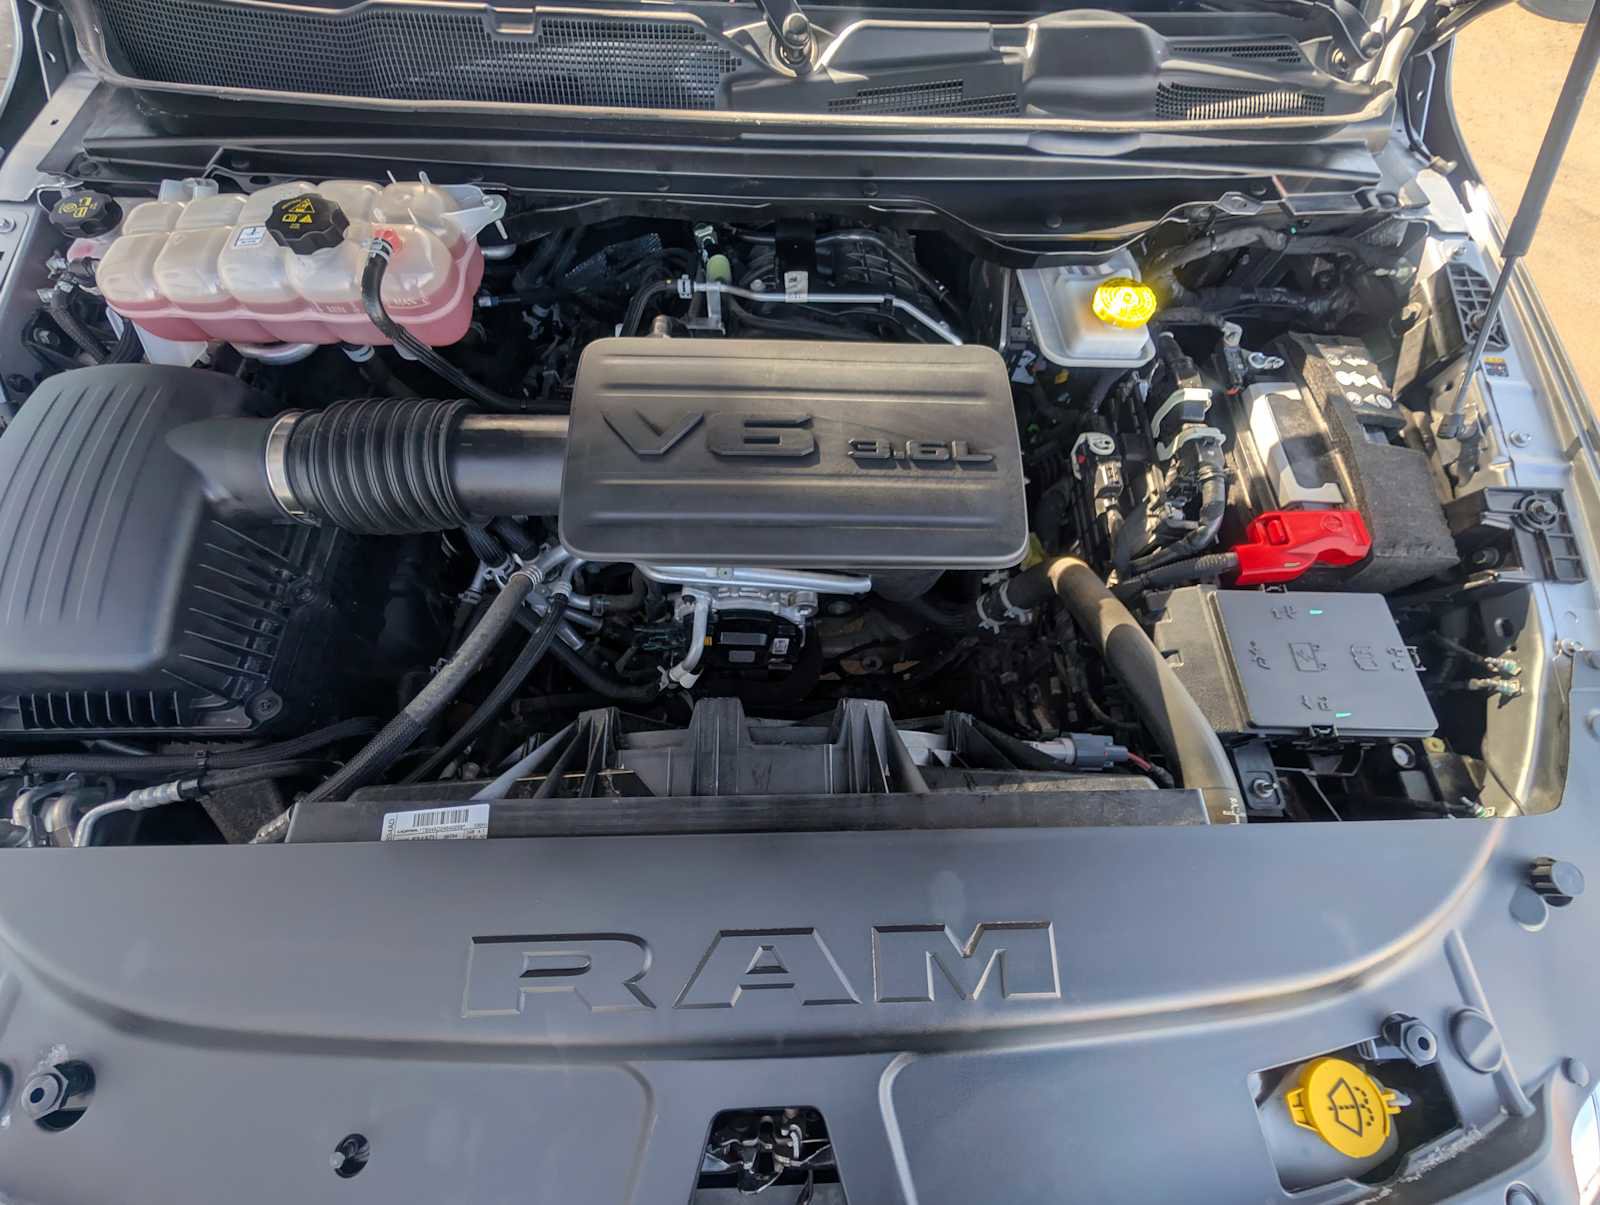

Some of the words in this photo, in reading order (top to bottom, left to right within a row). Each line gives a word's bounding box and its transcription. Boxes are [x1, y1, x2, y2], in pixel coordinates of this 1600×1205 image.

[601, 411, 818, 462] V6
[847, 437, 997, 469] 3.6L
[461, 920, 1062, 1018] RAM
